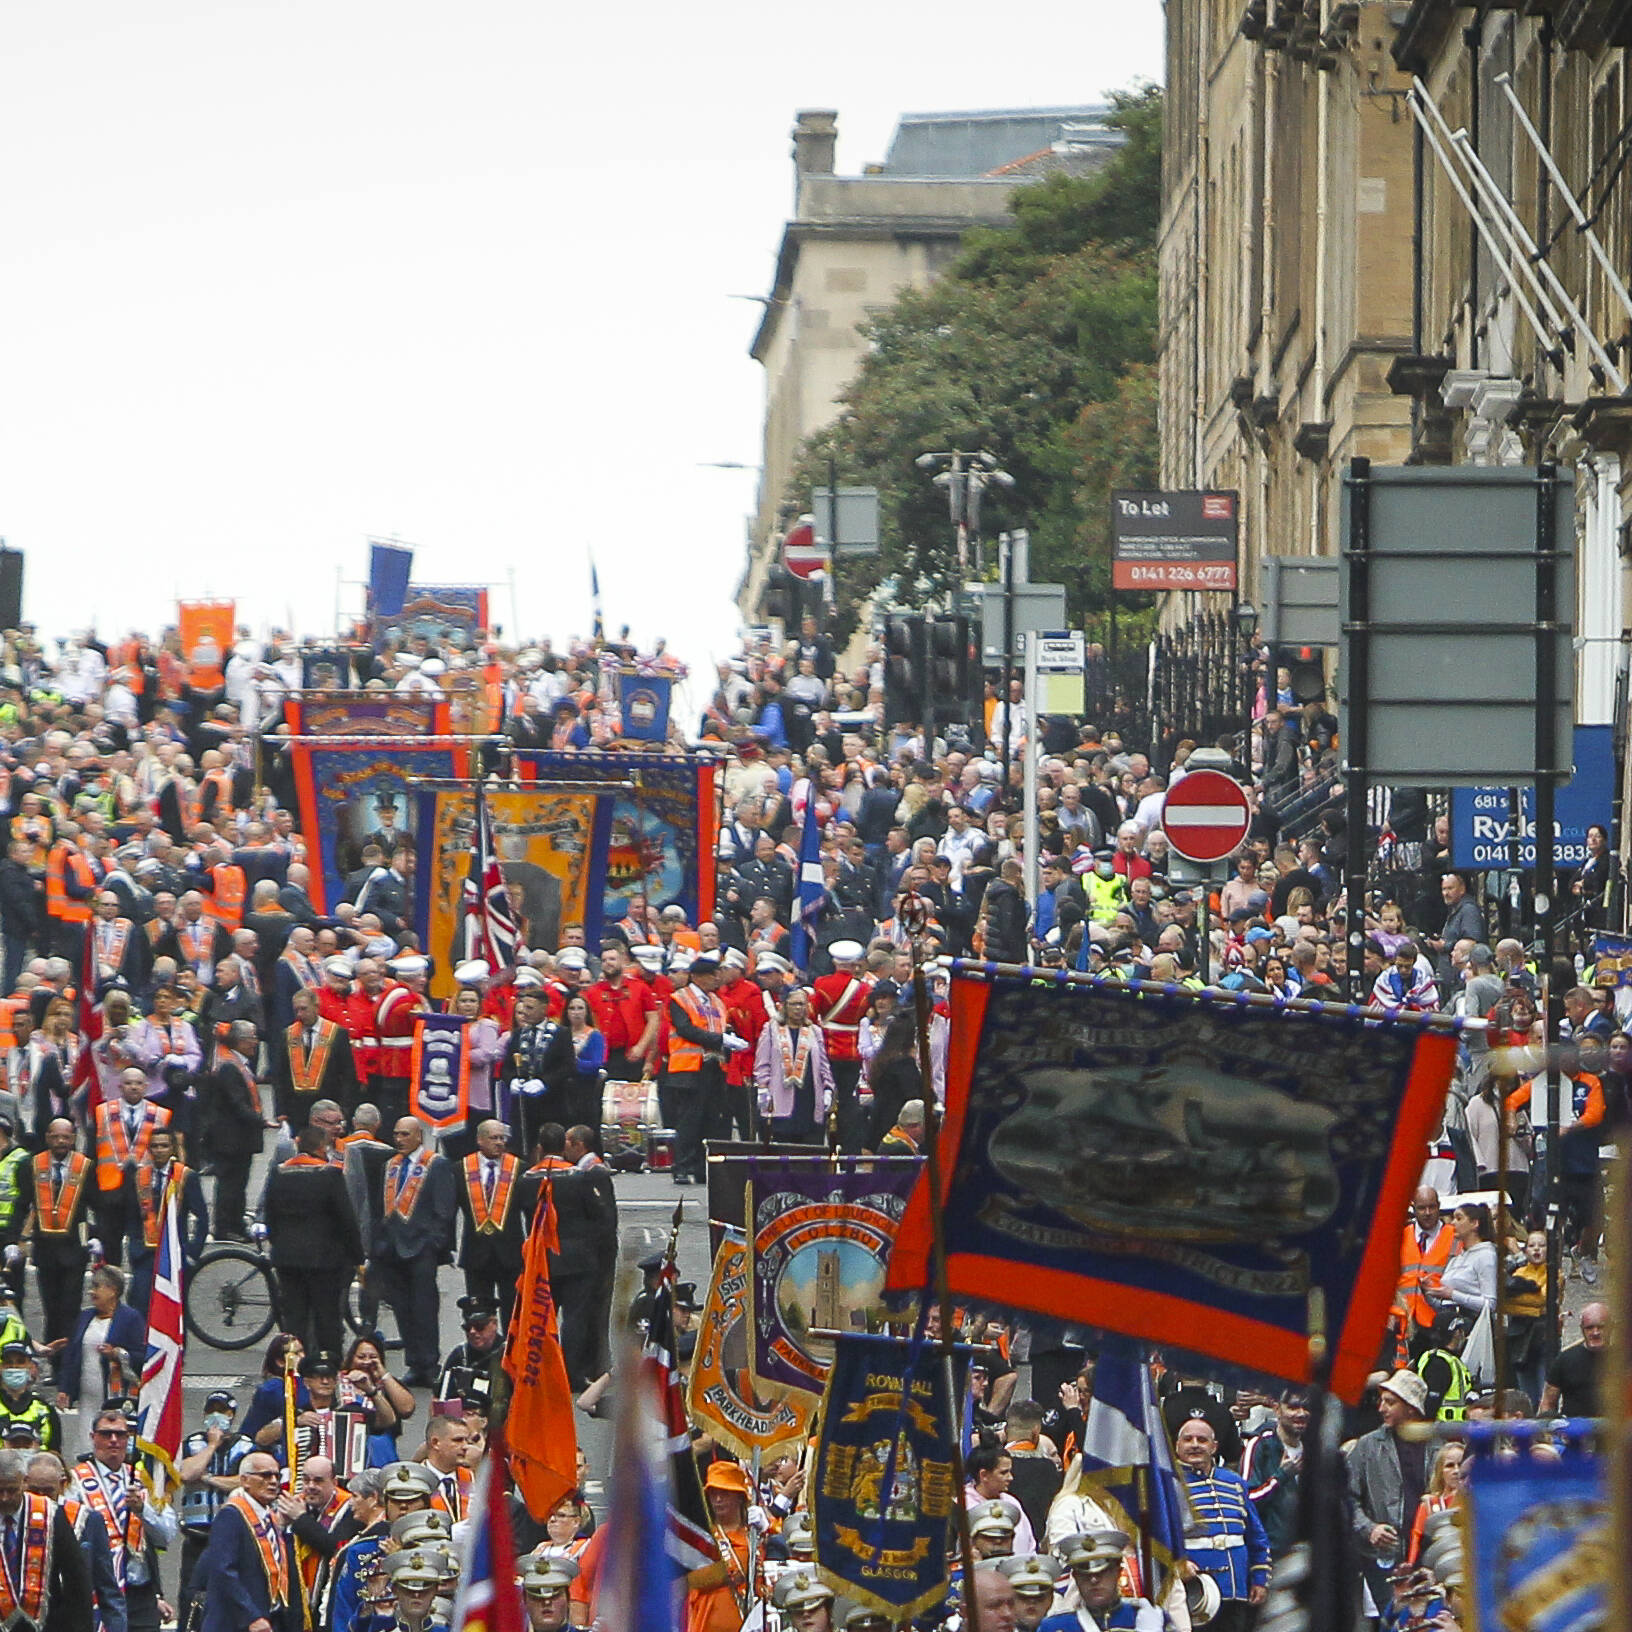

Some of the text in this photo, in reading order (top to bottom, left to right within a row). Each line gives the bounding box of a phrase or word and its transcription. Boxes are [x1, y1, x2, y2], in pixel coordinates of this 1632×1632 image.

[1119, 499, 1170, 516] To Let
[1131, 566, 1231, 580] 0141 226 6777
[1474, 795, 1497, 808] 681
[1474, 845, 1509, 861] 0141
[711, 1387, 768, 1433] PARKHEAD
